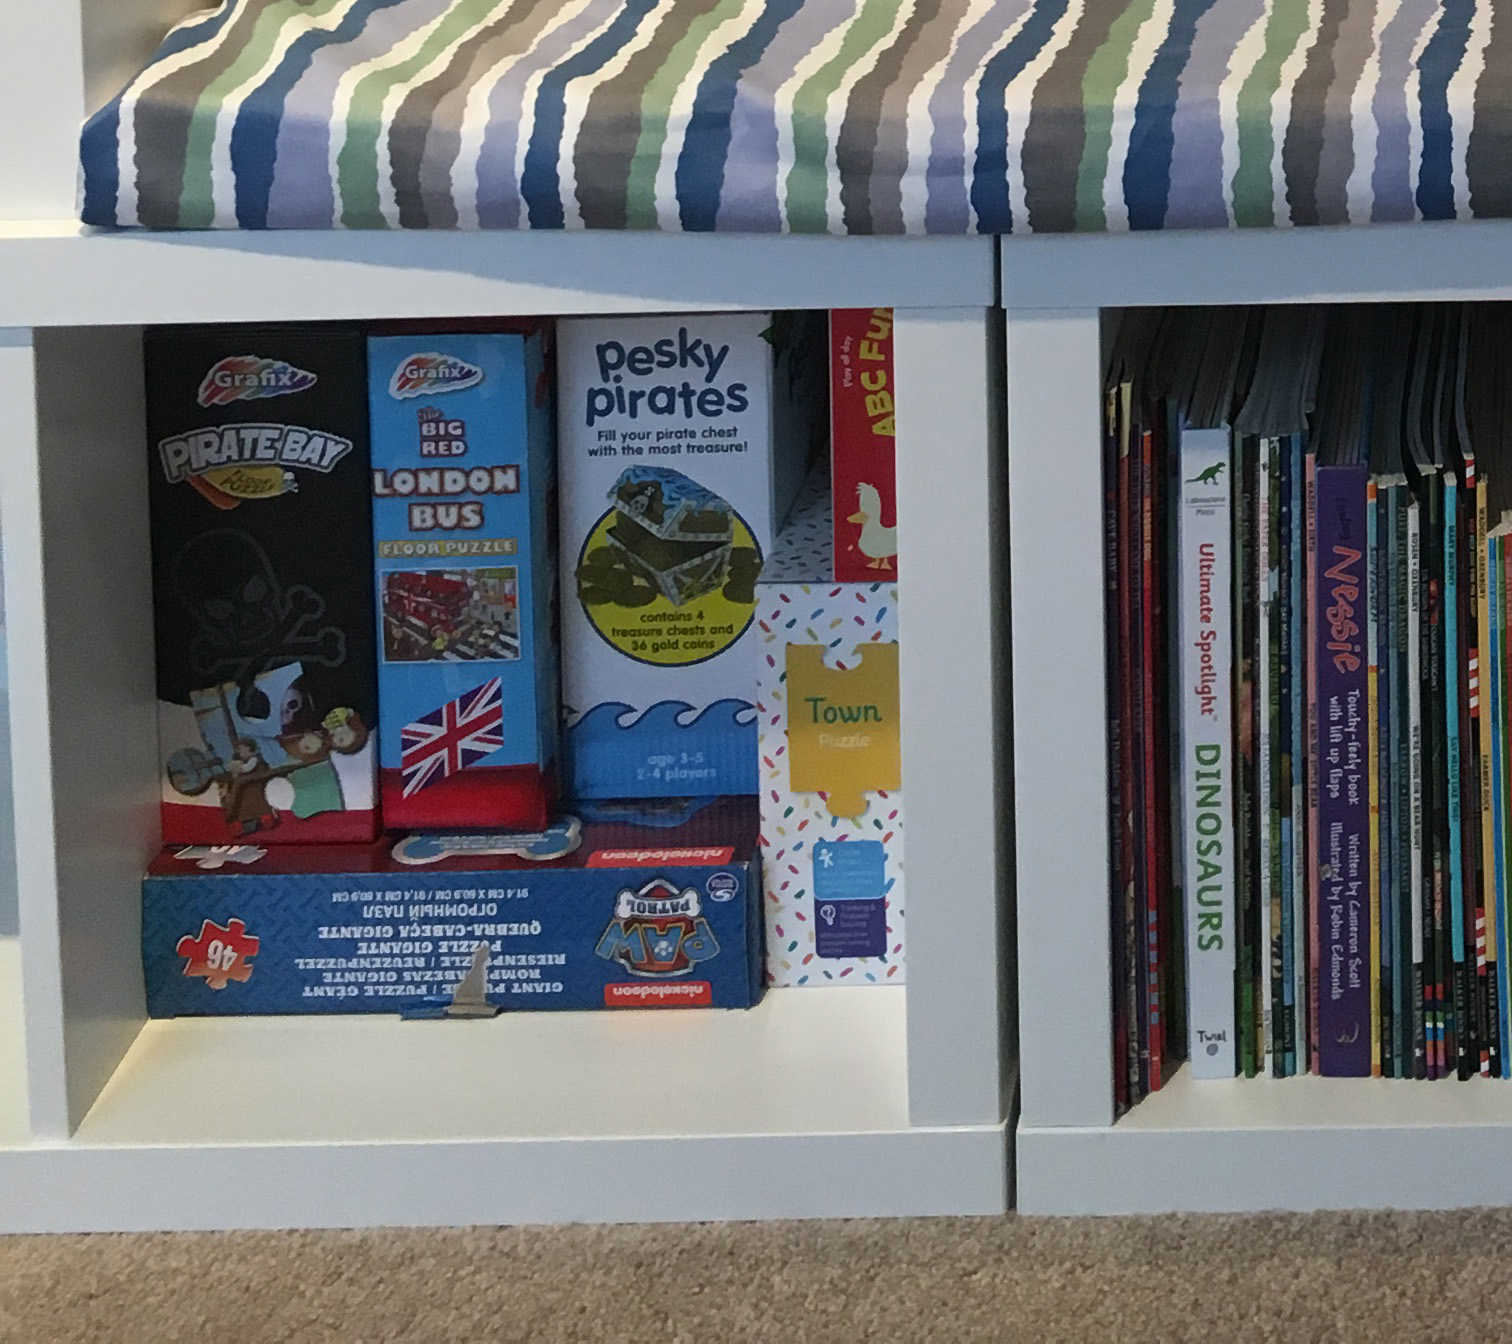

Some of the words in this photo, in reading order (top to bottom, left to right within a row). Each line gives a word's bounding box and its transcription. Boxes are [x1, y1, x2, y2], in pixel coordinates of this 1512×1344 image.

[596, 327, 729, 383] pesky
[214, 370, 293, 388] Grafix
[404, 364, 461, 379] Grafix
[586, 374, 749, 427] pirates
[860, 369, 895, 437] ABC
[421, 421, 464, 436] BIG
[598, 430, 616, 441] Fill
[621, 432, 651, 442] your
[656, 428, 696, 441] pirate
[702, 427, 737, 438] chest
[163, 428, 282, 479] PIRATE
[282, 431, 347, 468] BAY
[422, 441, 467, 455] RED
[588, 445, 617, 457] with
[622, 445, 643, 456] the
[648, 443, 682, 454] most
[687, 441, 748, 453] treasure!
[373, 465, 518, 495] LONDON
[410, 502, 482, 529] BUS
[445, 539, 514, 555] PUZZLE
[1199, 543, 1215, 623] Ultimate
[640, 611, 692, 623] contains
[1324, 545, 1362, 674] Nessie
[611, 627, 662, 637] treasure
[710, 624, 733, 634] and
[632, 641, 647, 651] 36
[652, 639, 678, 652] gold
[1195, 631, 1216, 715] Spotlight
[804, 696, 883, 725] Town
[1330, 695, 1343, 720] with
[1330, 725, 1343, 742] lift
[1326, 748, 1340, 763] up
[1348, 774, 1361, 805] book
[1196, 743, 1223, 951] DINOSAURS
[1330, 822, 1344, 881] Illustrated
[1348, 833, 1361, 877] Written
[1327, 885, 1342, 900] by
[1346, 881, 1361, 895] by
[626, 899, 690, 914] PATROL
[318, 925, 393, 939] GIGANTE
[398, 920, 541, 938] QUEBRA-CABEÇA
[1331, 904, 1344, 939] Robin
[1348, 900, 1361, 953] Cameron
[357, 941, 433, 954] GIGANTE
[594, 917, 721, 964] PAW
[206, 939, 238, 972] 46
[322, 971, 398, 983] GIGANTE
[1331, 944, 1344, 1000] Edmonds
[1349, 957, 1362, 988] Scott
[364, 985, 427, 996] PUZZLE
[511, 982, 564, 994] GIANT
